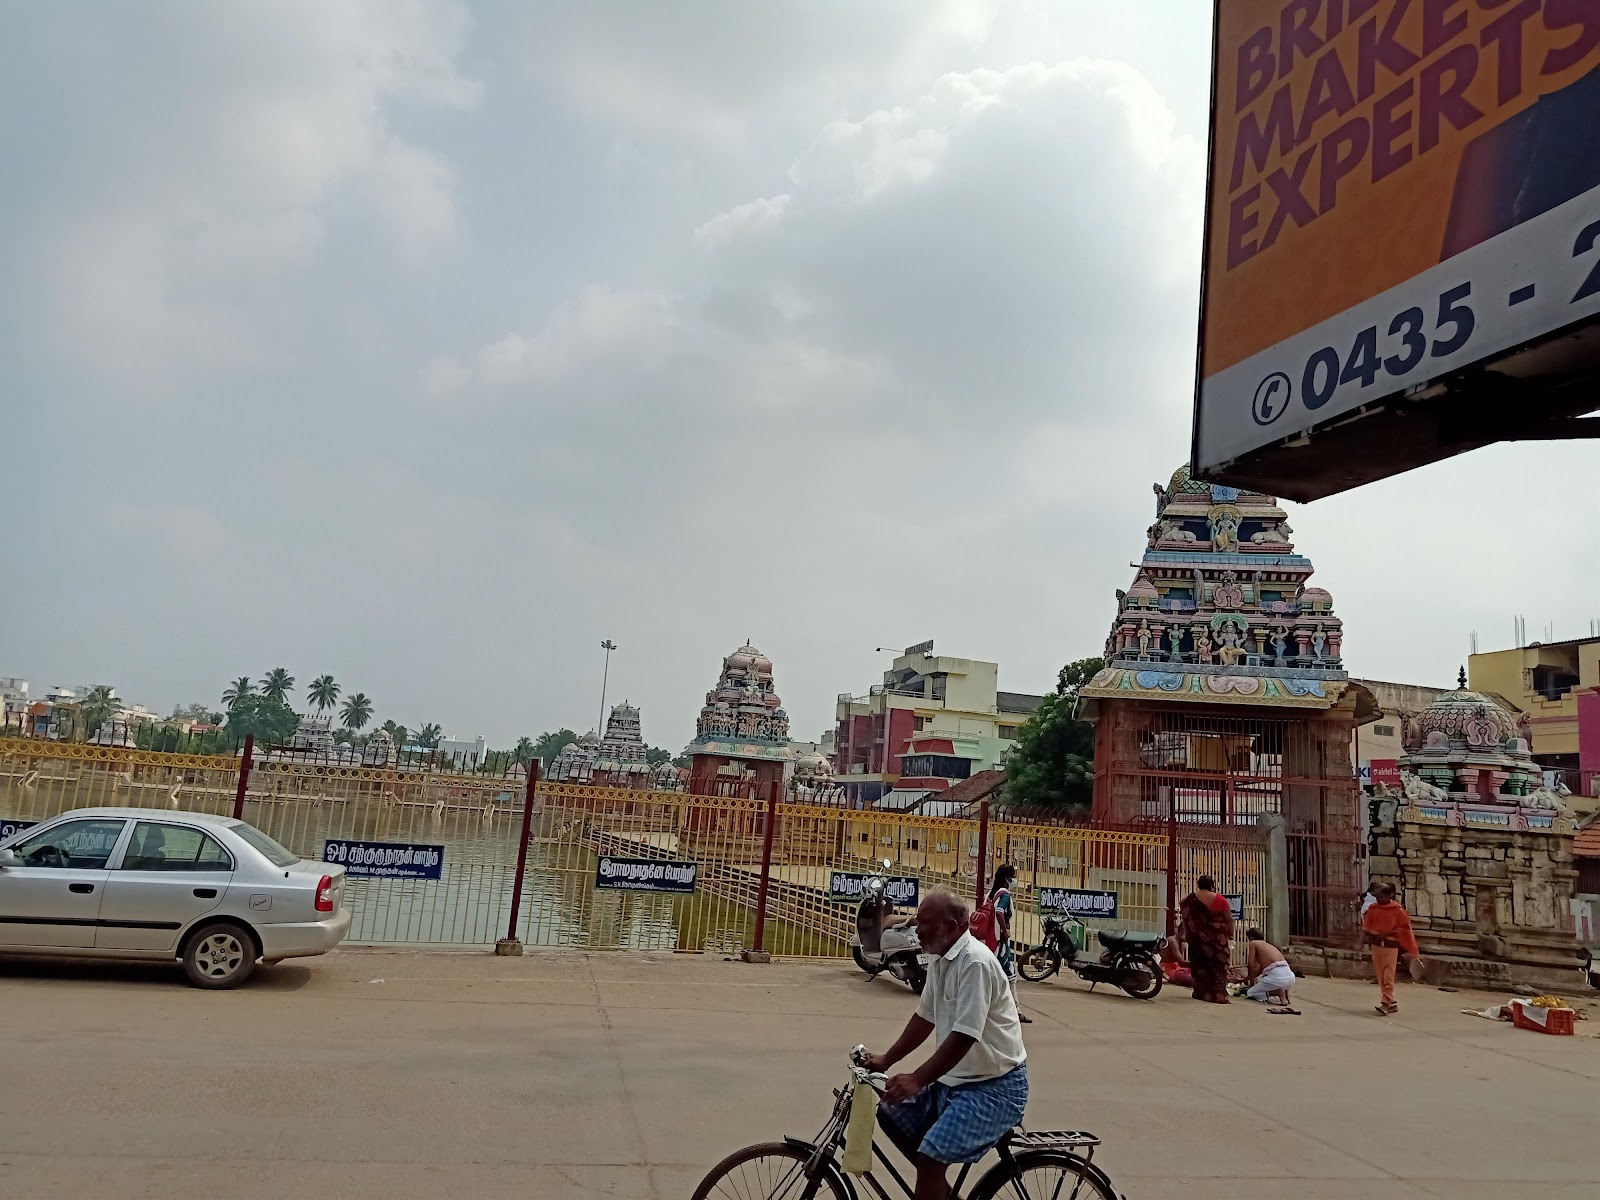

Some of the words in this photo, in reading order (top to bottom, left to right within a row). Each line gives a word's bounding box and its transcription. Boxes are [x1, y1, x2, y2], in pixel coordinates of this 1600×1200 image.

[1235, 0, 1378, 115] BRI
[1228, 0, 1513, 195] MAKE
[1227, 0, 1600, 272] EXPERTS
[1301, 281, 1475, 410] 0435
[413, 847, 439, 867] வாழ்க
[600, 858, 665, 880] இராமநாதனே
[664, 863, 696, 883] போற்றி
[886, 878, 915, 898] வாழ்க
[1093, 892, 1115, 911] வாழ்க
